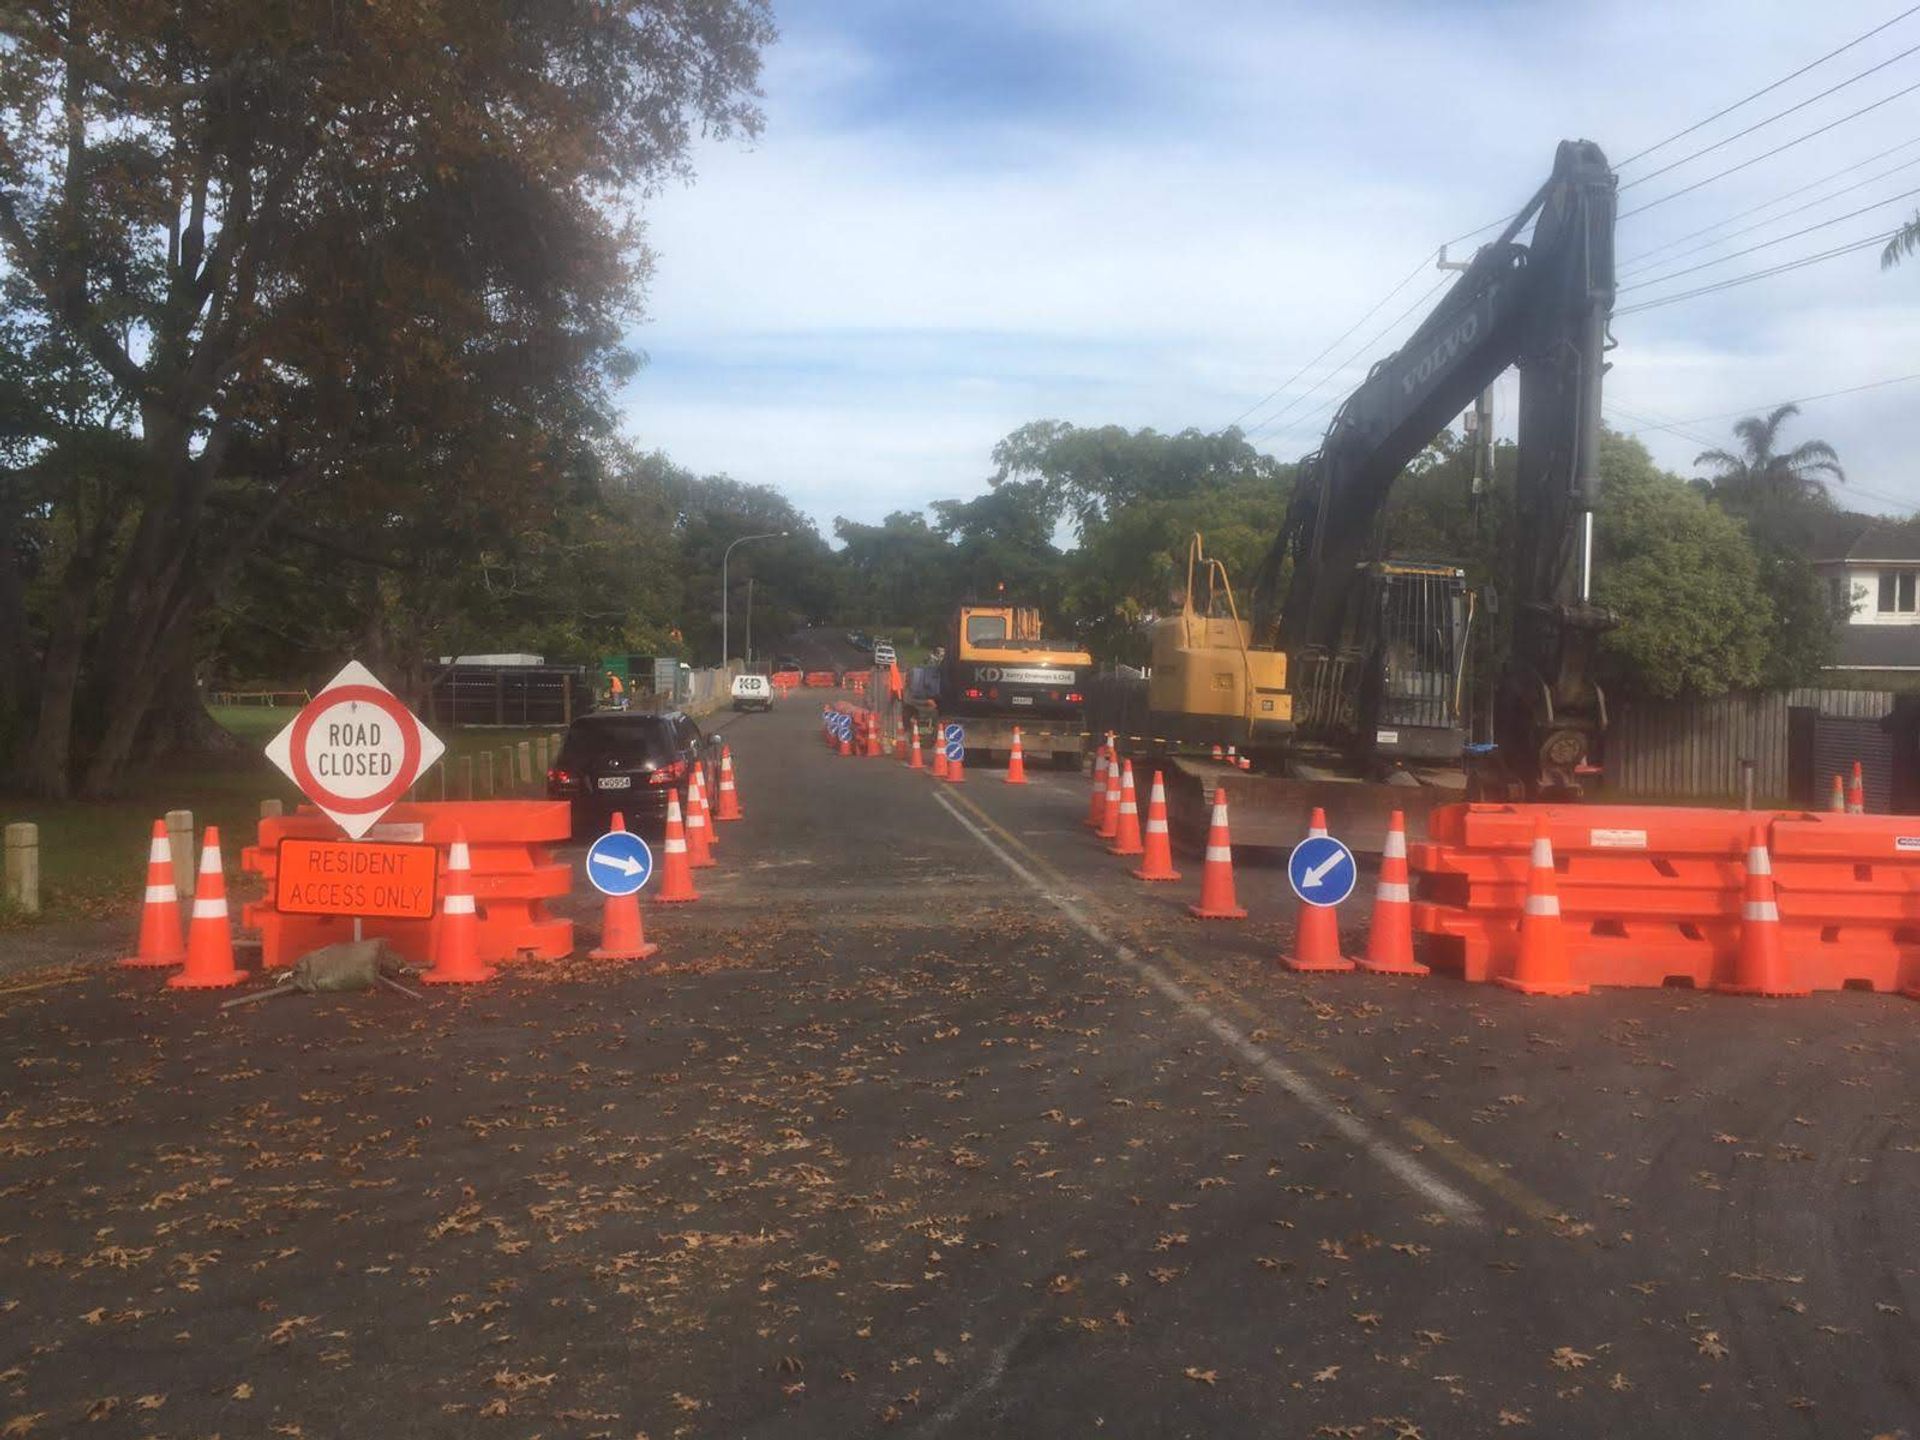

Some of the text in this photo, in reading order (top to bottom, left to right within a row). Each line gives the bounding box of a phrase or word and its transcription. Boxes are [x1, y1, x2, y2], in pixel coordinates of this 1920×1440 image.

[1402, 313, 1477, 394] VOLVO
[739, 677, 761, 689] KD
[975, 667, 1000, 682] KD
[330, 723, 381, 746] ROAD
[319, 753, 392, 777] CLOSED
[308, 850, 408, 875] RESIDENT
[290, 883, 423, 909] ACCESS ONLY
